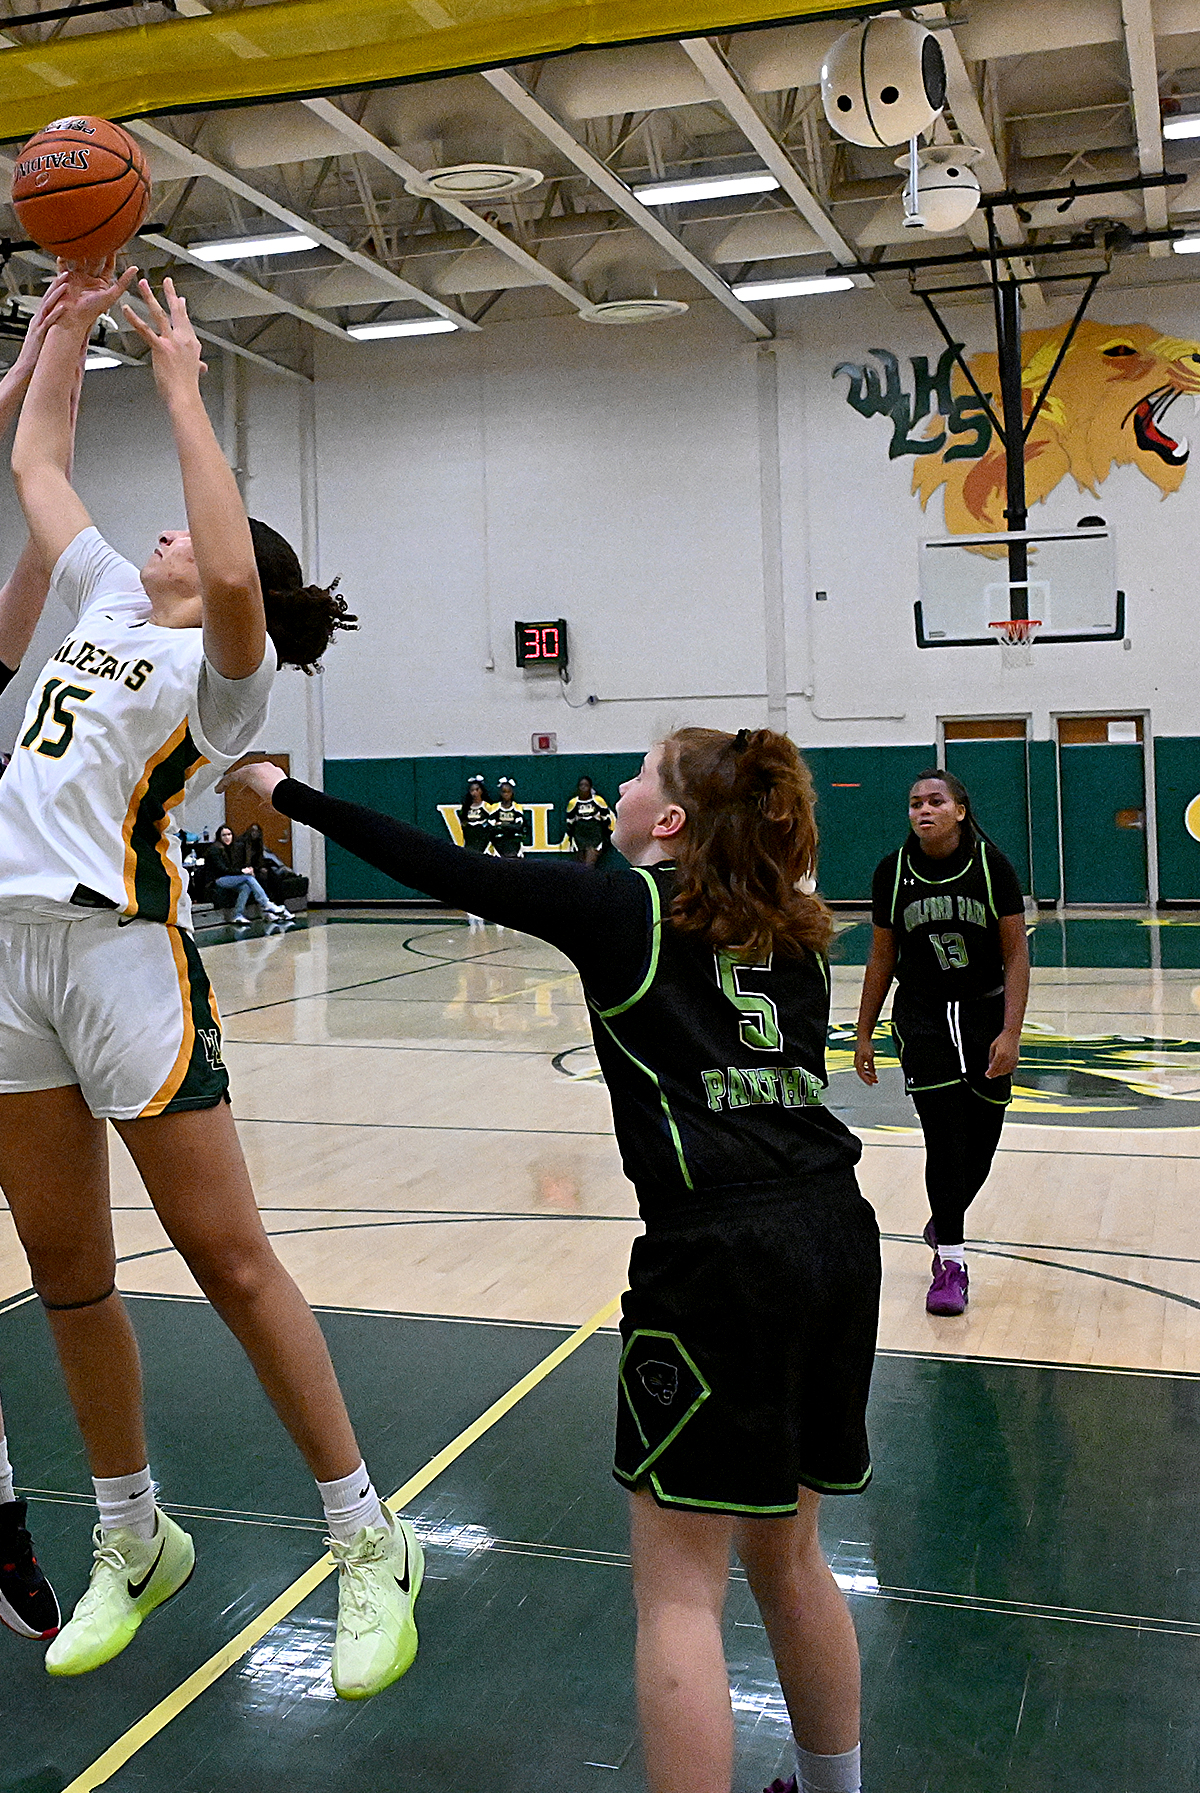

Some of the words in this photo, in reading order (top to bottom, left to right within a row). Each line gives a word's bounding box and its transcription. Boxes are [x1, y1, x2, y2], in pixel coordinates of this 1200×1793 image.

[524, 627, 559, 659] 30
[20, 676, 96, 761] 15
[928, 932, 970, 971] 13
[713, 945, 784, 1053] 5
